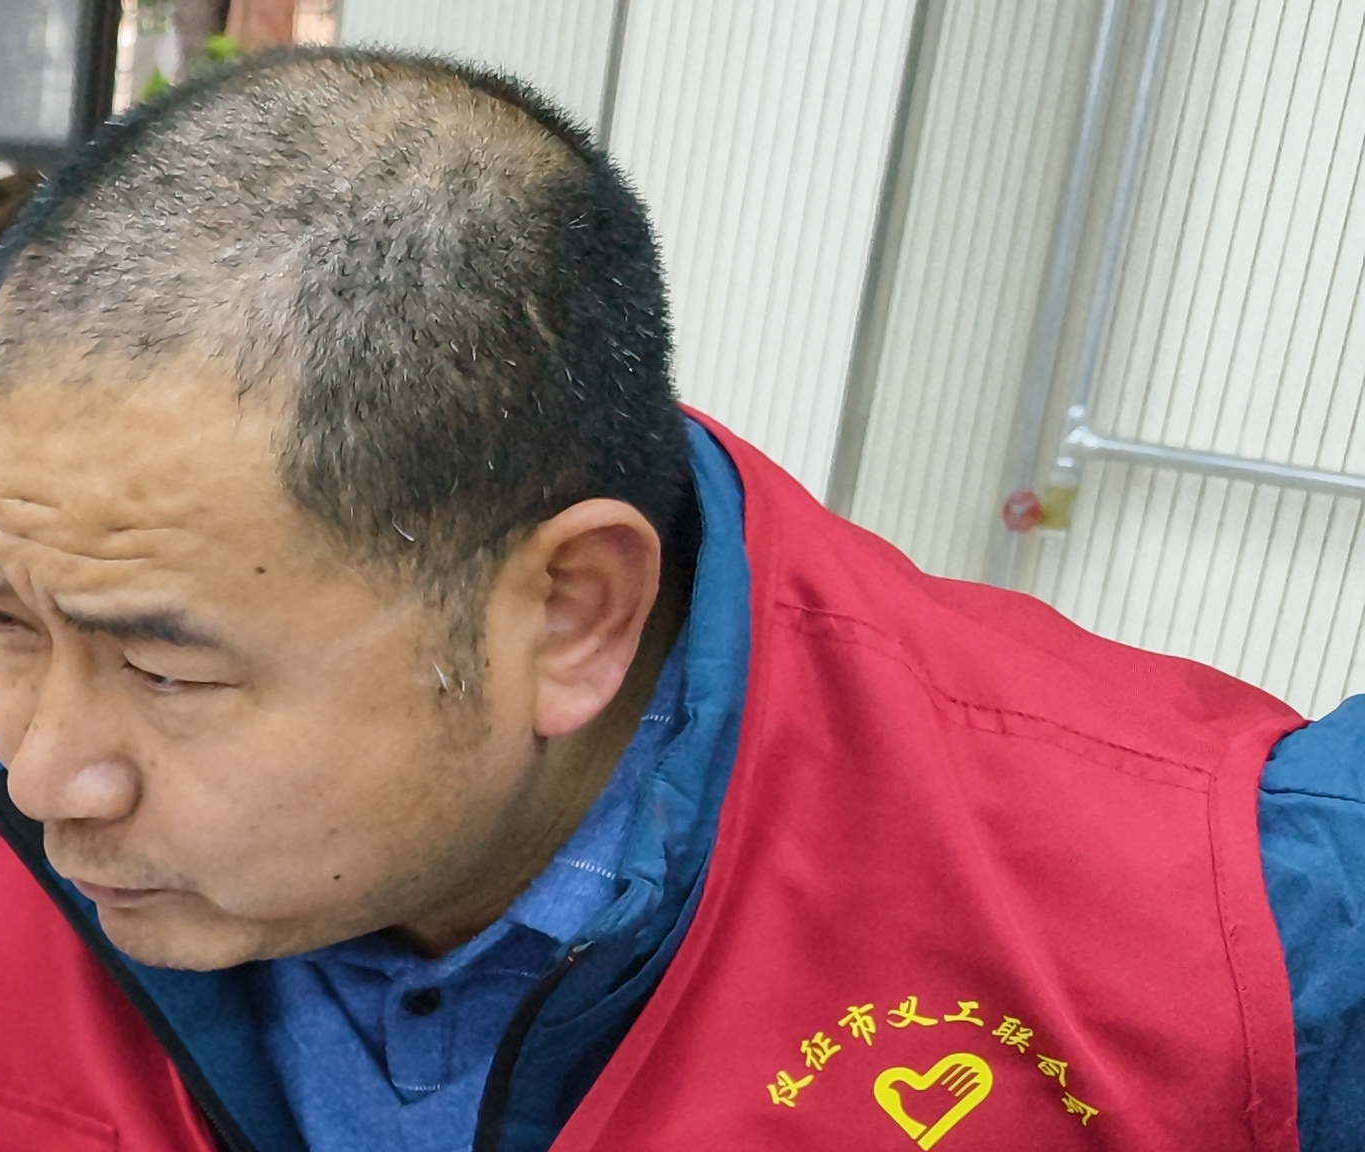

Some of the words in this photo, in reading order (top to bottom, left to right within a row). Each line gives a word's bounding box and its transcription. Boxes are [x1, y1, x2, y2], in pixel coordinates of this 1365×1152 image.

[767, 995, 1099, 1126] 仪征市义工联合会
